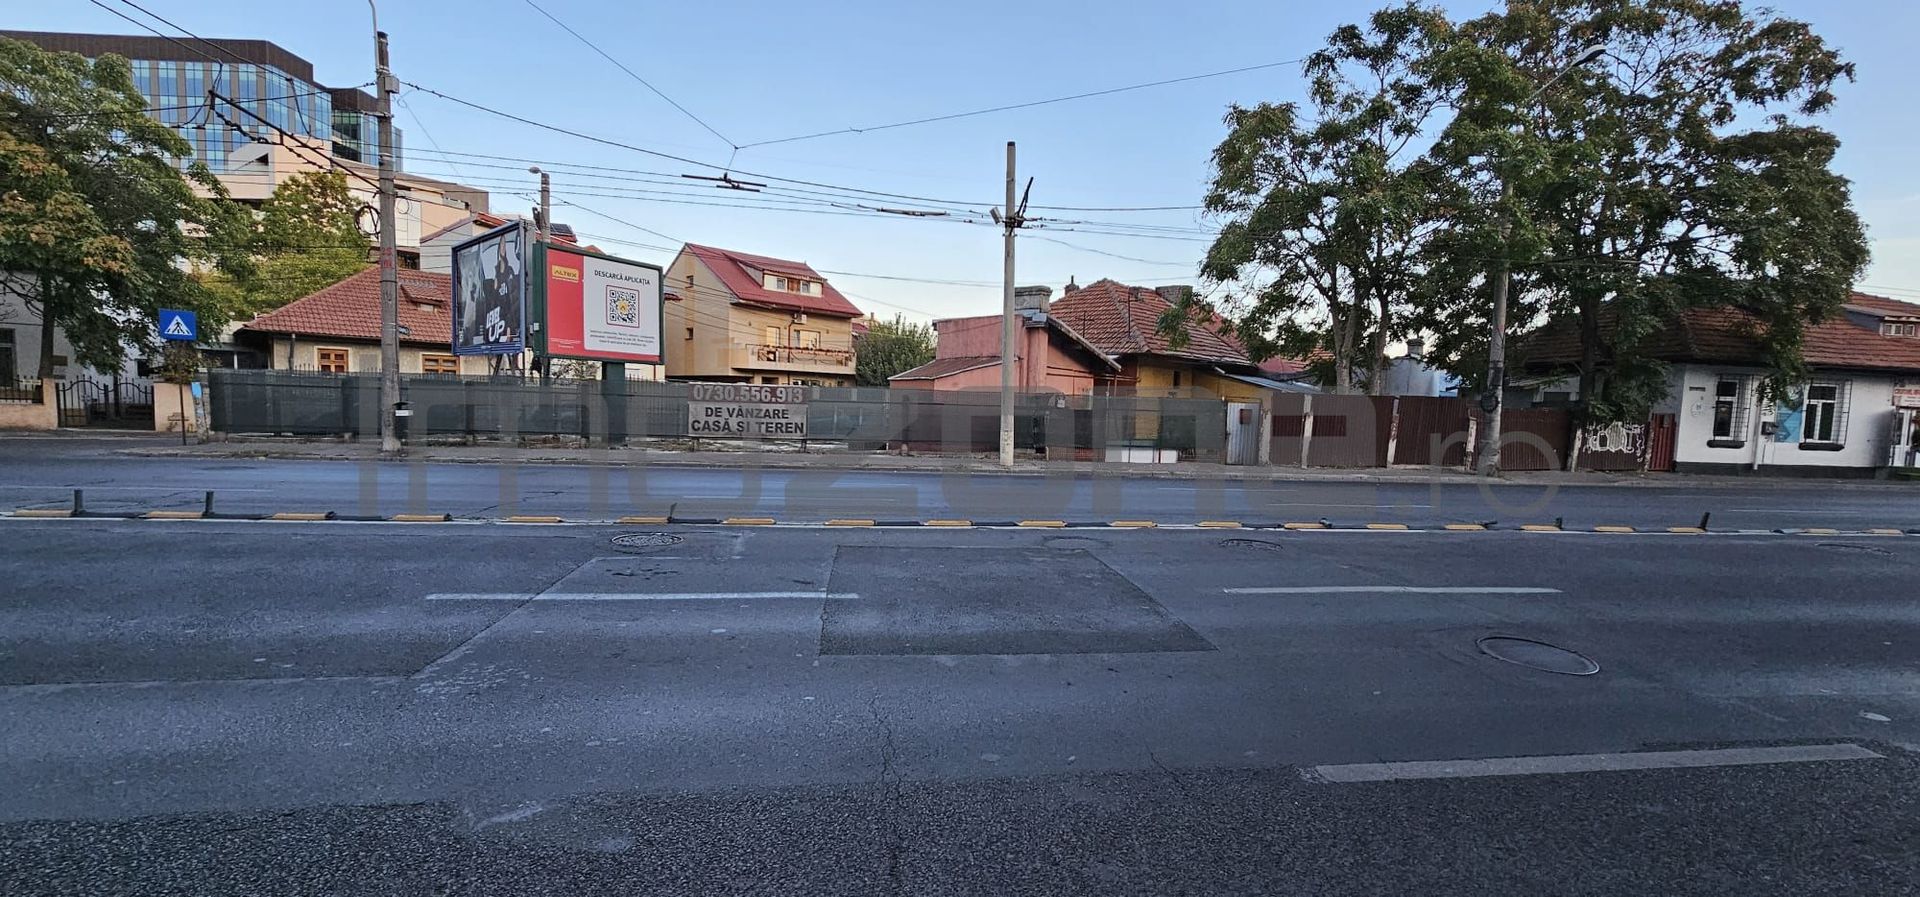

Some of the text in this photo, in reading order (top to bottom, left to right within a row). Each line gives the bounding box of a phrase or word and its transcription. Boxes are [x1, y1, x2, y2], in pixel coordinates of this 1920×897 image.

[489, 320, 505, 342] UP
[693, 384, 804, 403] 0730.556.913
[704, 405, 790, 420] DE VÂNZARE
[691, 418, 732, 433] CASĂ
[755, 421, 804, 434] TEREN
